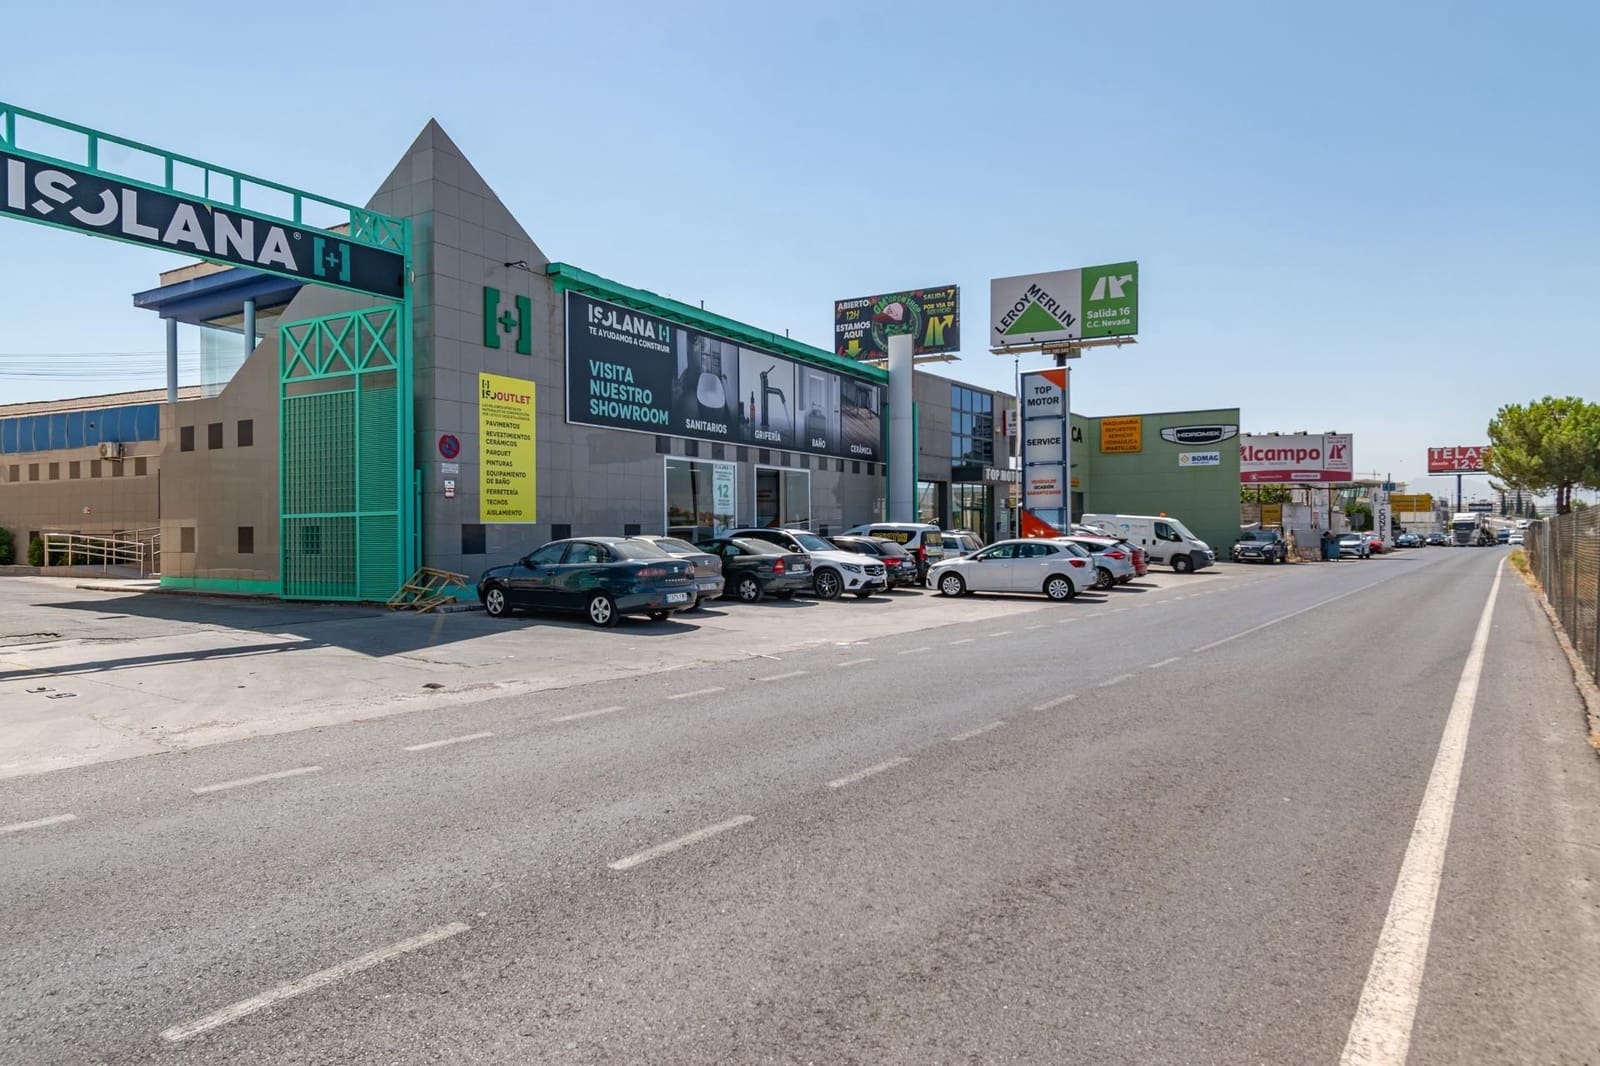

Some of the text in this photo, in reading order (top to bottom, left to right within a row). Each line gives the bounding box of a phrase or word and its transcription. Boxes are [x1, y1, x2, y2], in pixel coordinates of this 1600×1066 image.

[923, 289, 955, 300] SALIDA 7
[838, 299, 869, 311] ABIERTO
[1027, 283, 1076, 328] MERLIN
[846, 310, 860, 320] 12H
[994, 293, 1032, 334] LEROY
[1087, 306, 1130, 319] Salida 16
[588, 303, 655, 339] ISOLANA
[836, 321, 871, 332] ESTAMOS
[1102, 318, 1130, 327] Nevada
[588, 326, 597, 335] TE
[598, 328, 632, 345] AYUDAMOS
[638, 339, 670, 353] CONSTRUIR
[843, 330, 863, 339] AQUI
[589, 360, 634, 384] VISITA
[590, 379, 653, 405] NUESTRO
[1034, 386, 1052, 394] TOP
[1027, 396, 1059, 407] MOTOR
[590, 399, 669, 425] SHOWROOM
[486, 419, 520, 430] PAVIMENTOS
[685, 418, 728, 434] SANITARIOS
[486, 430, 531, 441] REVESTIMIENTOS
[754, 429, 781, 443] GRIFERÍA
[811, 438, 826, 448] BAÑO
[1026, 437, 1061, 446] SERVICE
[486, 449, 511, 457] PARQUET
[850, 444, 872, 456] CERÁMICA
[486, 459, 513, 467] PINTURAS
[486, 469, 527, 479] EQUIPAMIENTO
[985, 468, 1000, 481] TOP
[495, 477, 511, 485] BAÑO
[486, 488, 519, 496] FERRETERÍA
[486, 498, 508, 506] TECHOS
